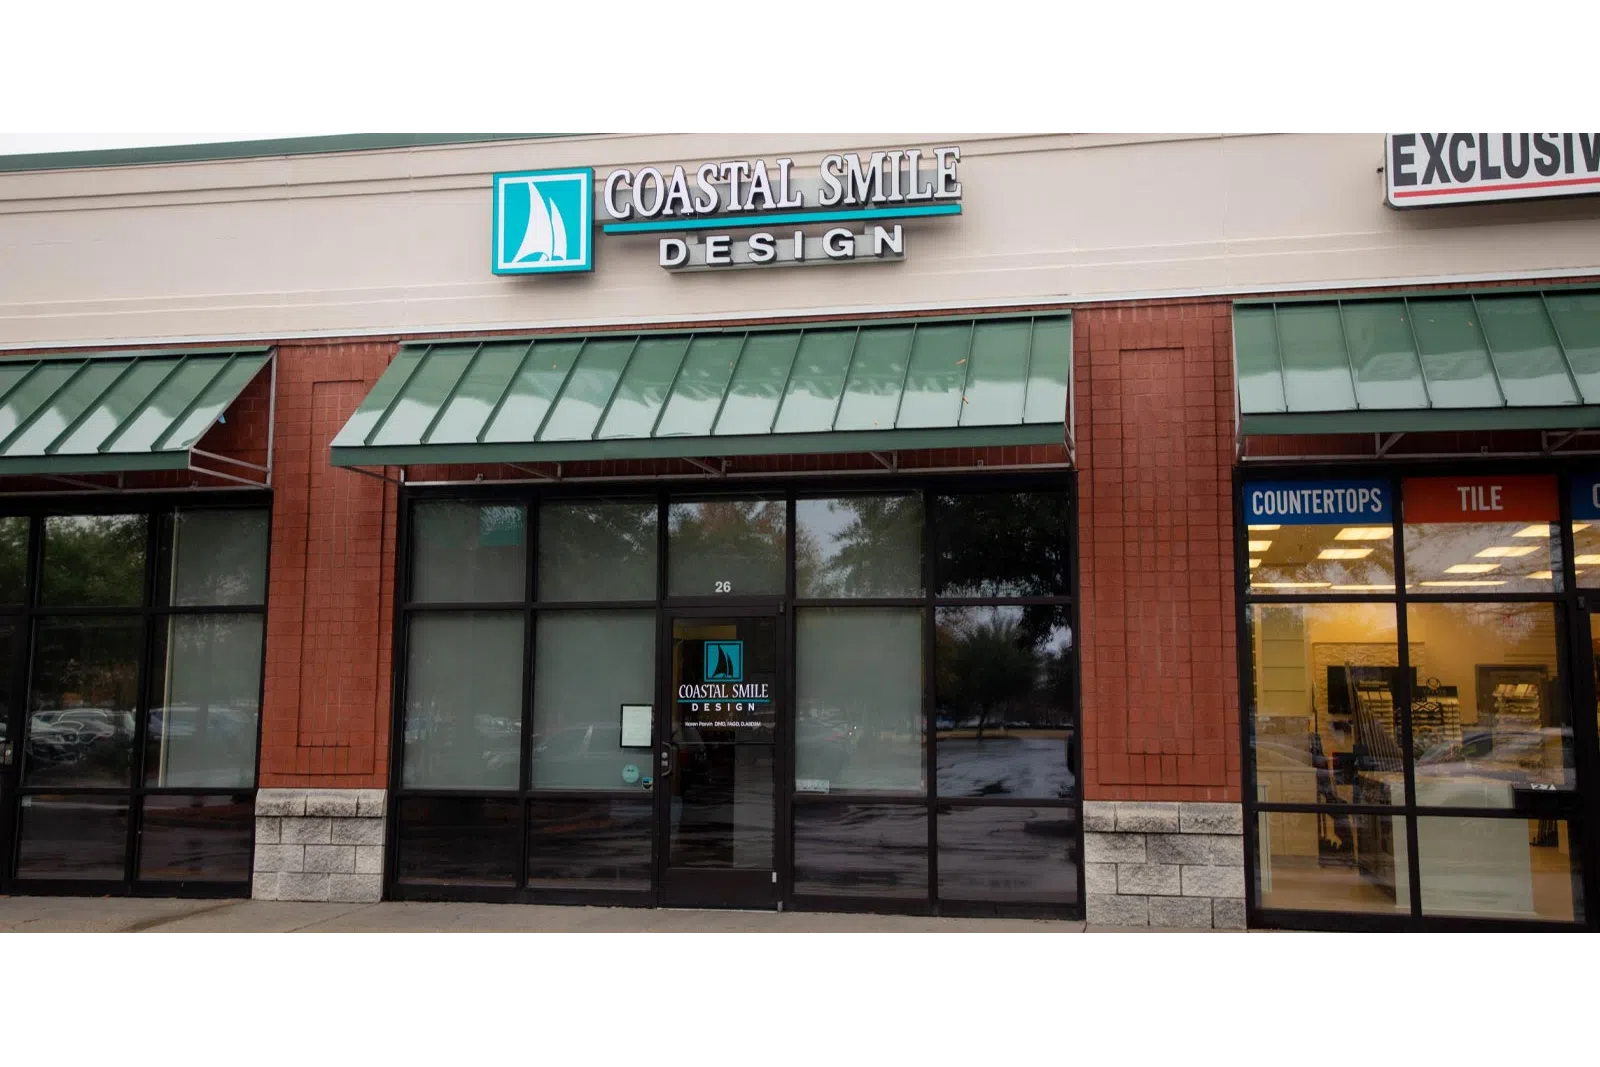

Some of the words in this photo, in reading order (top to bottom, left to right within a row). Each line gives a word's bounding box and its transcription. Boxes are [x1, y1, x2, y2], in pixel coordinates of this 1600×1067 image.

[603, 158, 802, 219] COASTAL
[819, 146, 963, 207] SMILE
[658, 225, 905, 267] DESIGN
[1252, 487, 1383, 516] COUNTERTOPS
[1457, 486, 1504, 512] TILE
[715, 581, 731, 593] 26
[678, 684, 729, 699] COASTAL
[732, 683, 769, 698] SMILE
[691, 702, 755, 712] DESIGN
